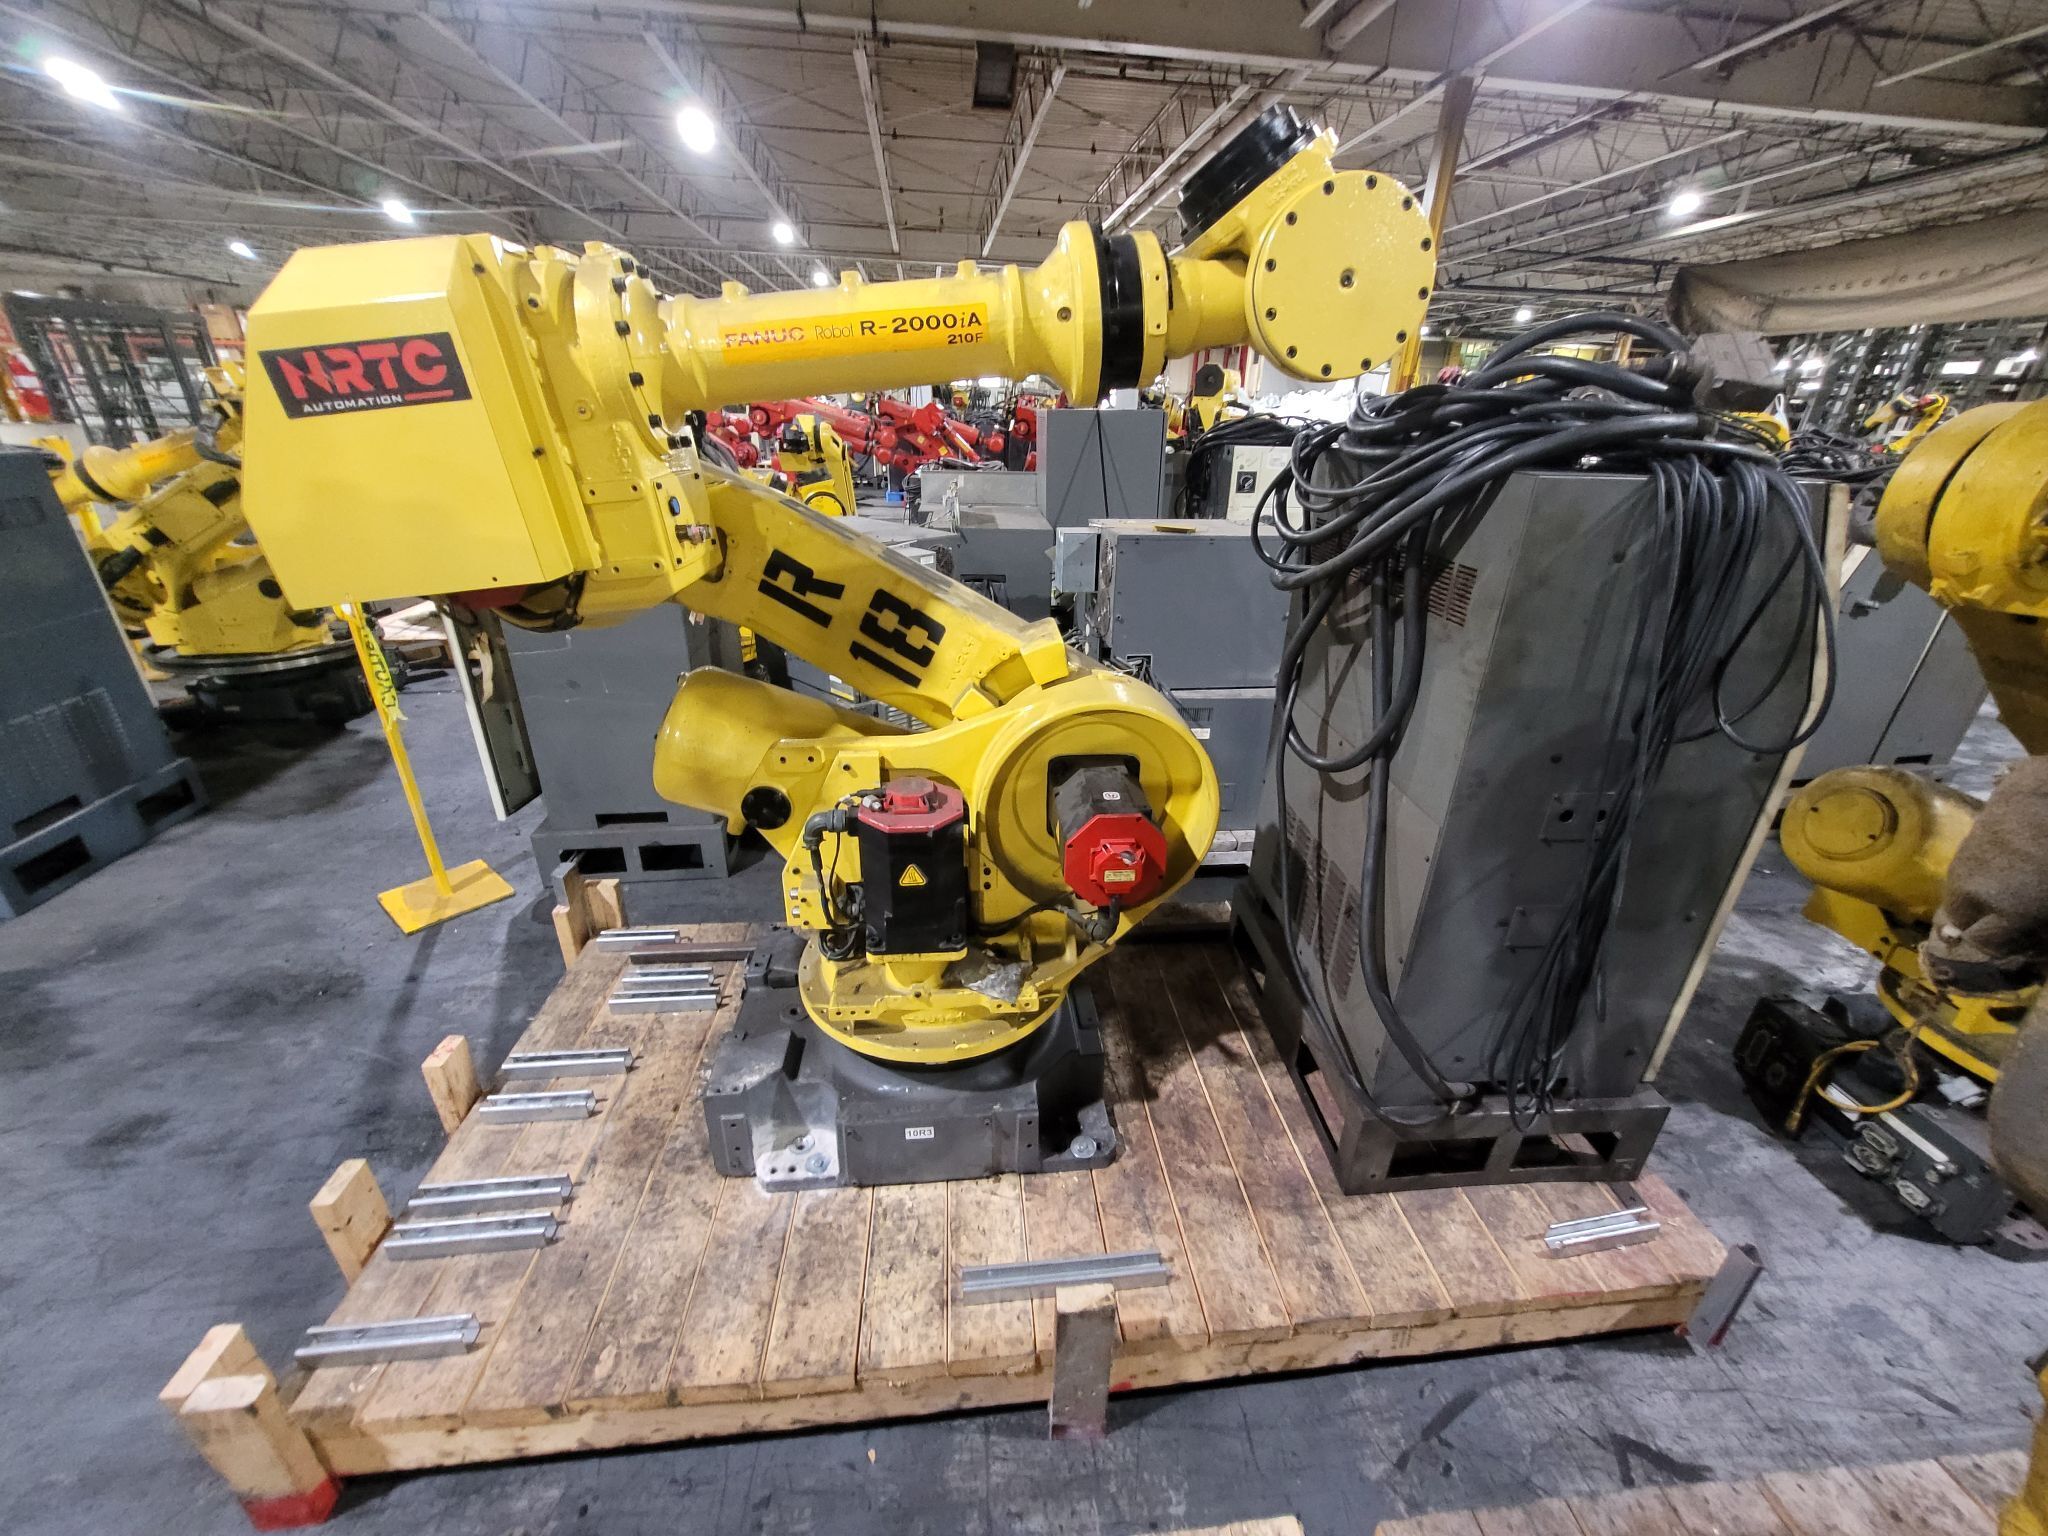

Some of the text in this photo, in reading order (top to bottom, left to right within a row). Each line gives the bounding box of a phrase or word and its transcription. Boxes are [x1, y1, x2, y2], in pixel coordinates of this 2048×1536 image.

[724, 326, 805, 348] FANUC
[859, 311, 982, 336] R-2000iA
[947, 332, 984, 345] 210F
[276, 338, 448, 400] NRTC
[303, 394, 403, 414] AUTOMATION
[757, 548, 846, 629] R
[849, 587, 947, 689] 18
[907, 1129, 933, 1137] 10R3
